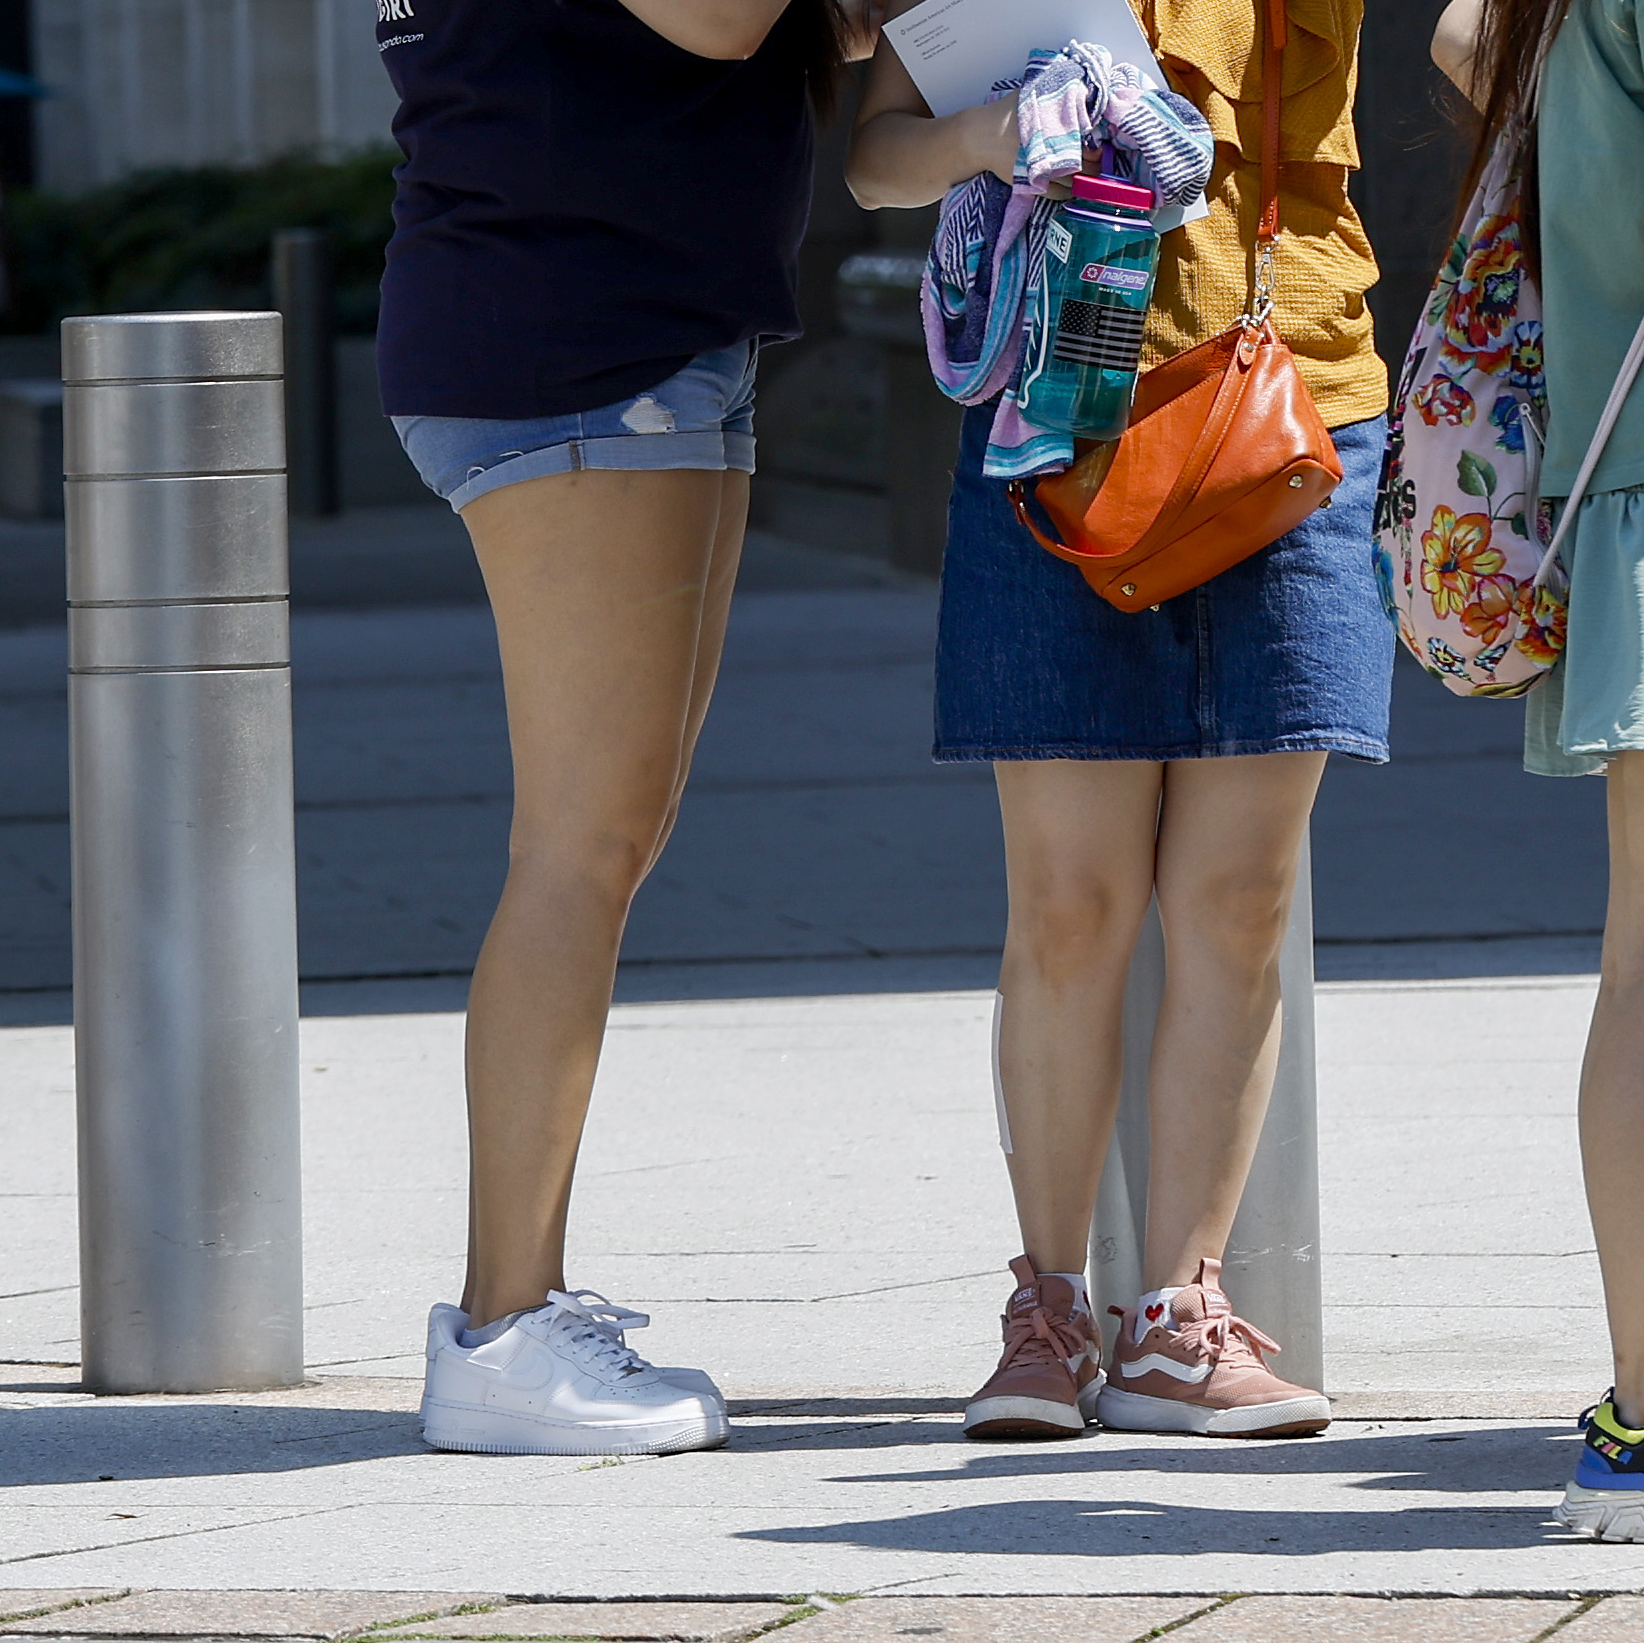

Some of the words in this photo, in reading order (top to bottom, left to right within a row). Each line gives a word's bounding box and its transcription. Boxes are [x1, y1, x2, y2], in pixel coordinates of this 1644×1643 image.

[1049, 227, 1068, 254] RNE
[1102, 268, 1146, 286] nalgene
[1593, 1435, 1634, 1465] FILA
